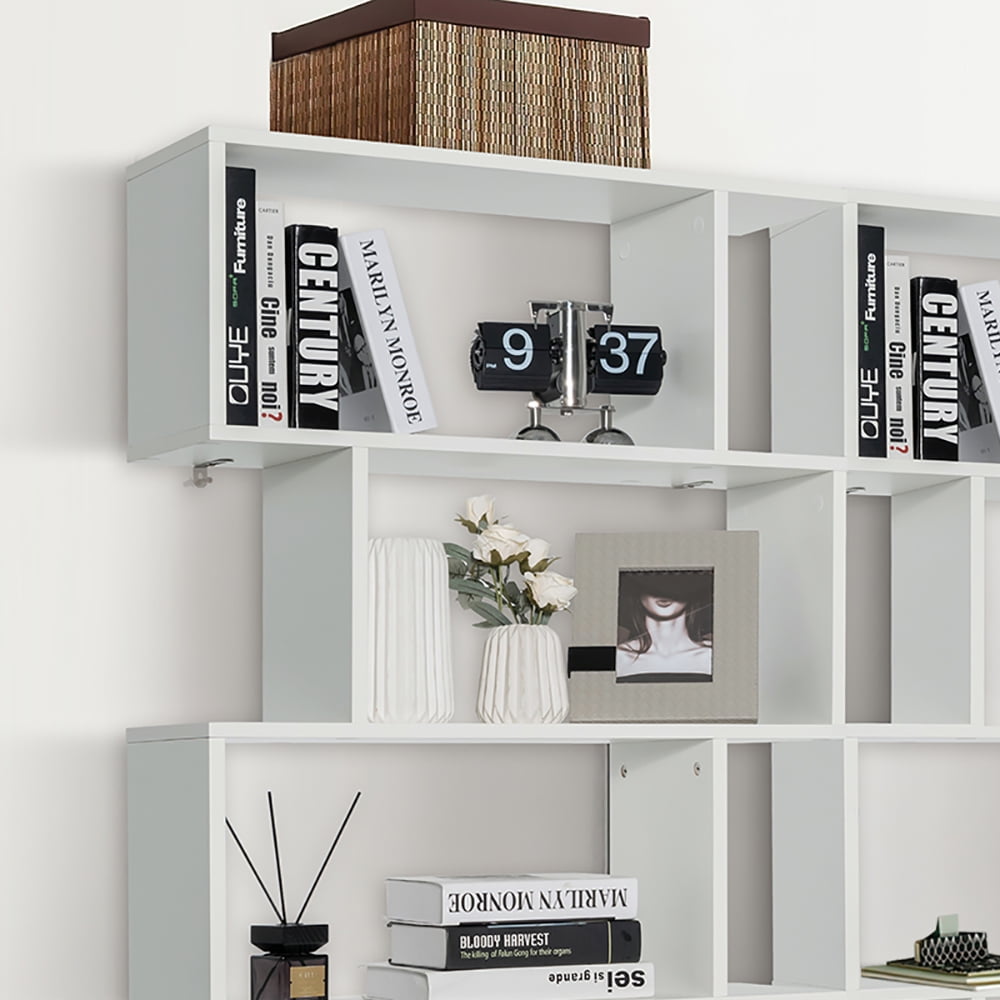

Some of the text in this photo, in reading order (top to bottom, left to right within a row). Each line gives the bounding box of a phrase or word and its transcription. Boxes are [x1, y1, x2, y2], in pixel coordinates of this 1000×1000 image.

[233, 198, 247, 274] Furniture
[864, 253, 877, 321] Furniture
[298, 242, 339, 411] CENTURY
[359, 239, 423, 424] MARILYN MONROE
[261, 296, 283, 422] Cine suntem noi?
[502, 328, 534, 371] 9
[600, 331, 659, 375] 37
[889, 341, 906, 379] Cine
[922, 292, 958, 444] CENTURY
[889, 417, 909, 454] noi?
[449, 888, 628, 912] MARILYN MONROE
[460, 932, 550, 949] BLOODY HARVEST
[460, 951, 471, 959] The
[472, 950, 489, 960] killing
[491, 949, 498, 957] of
[514, 949, 529, 958] Gong
[552, 948, 572, 957] organs
[548, 970, 646, 992] sei si grande
